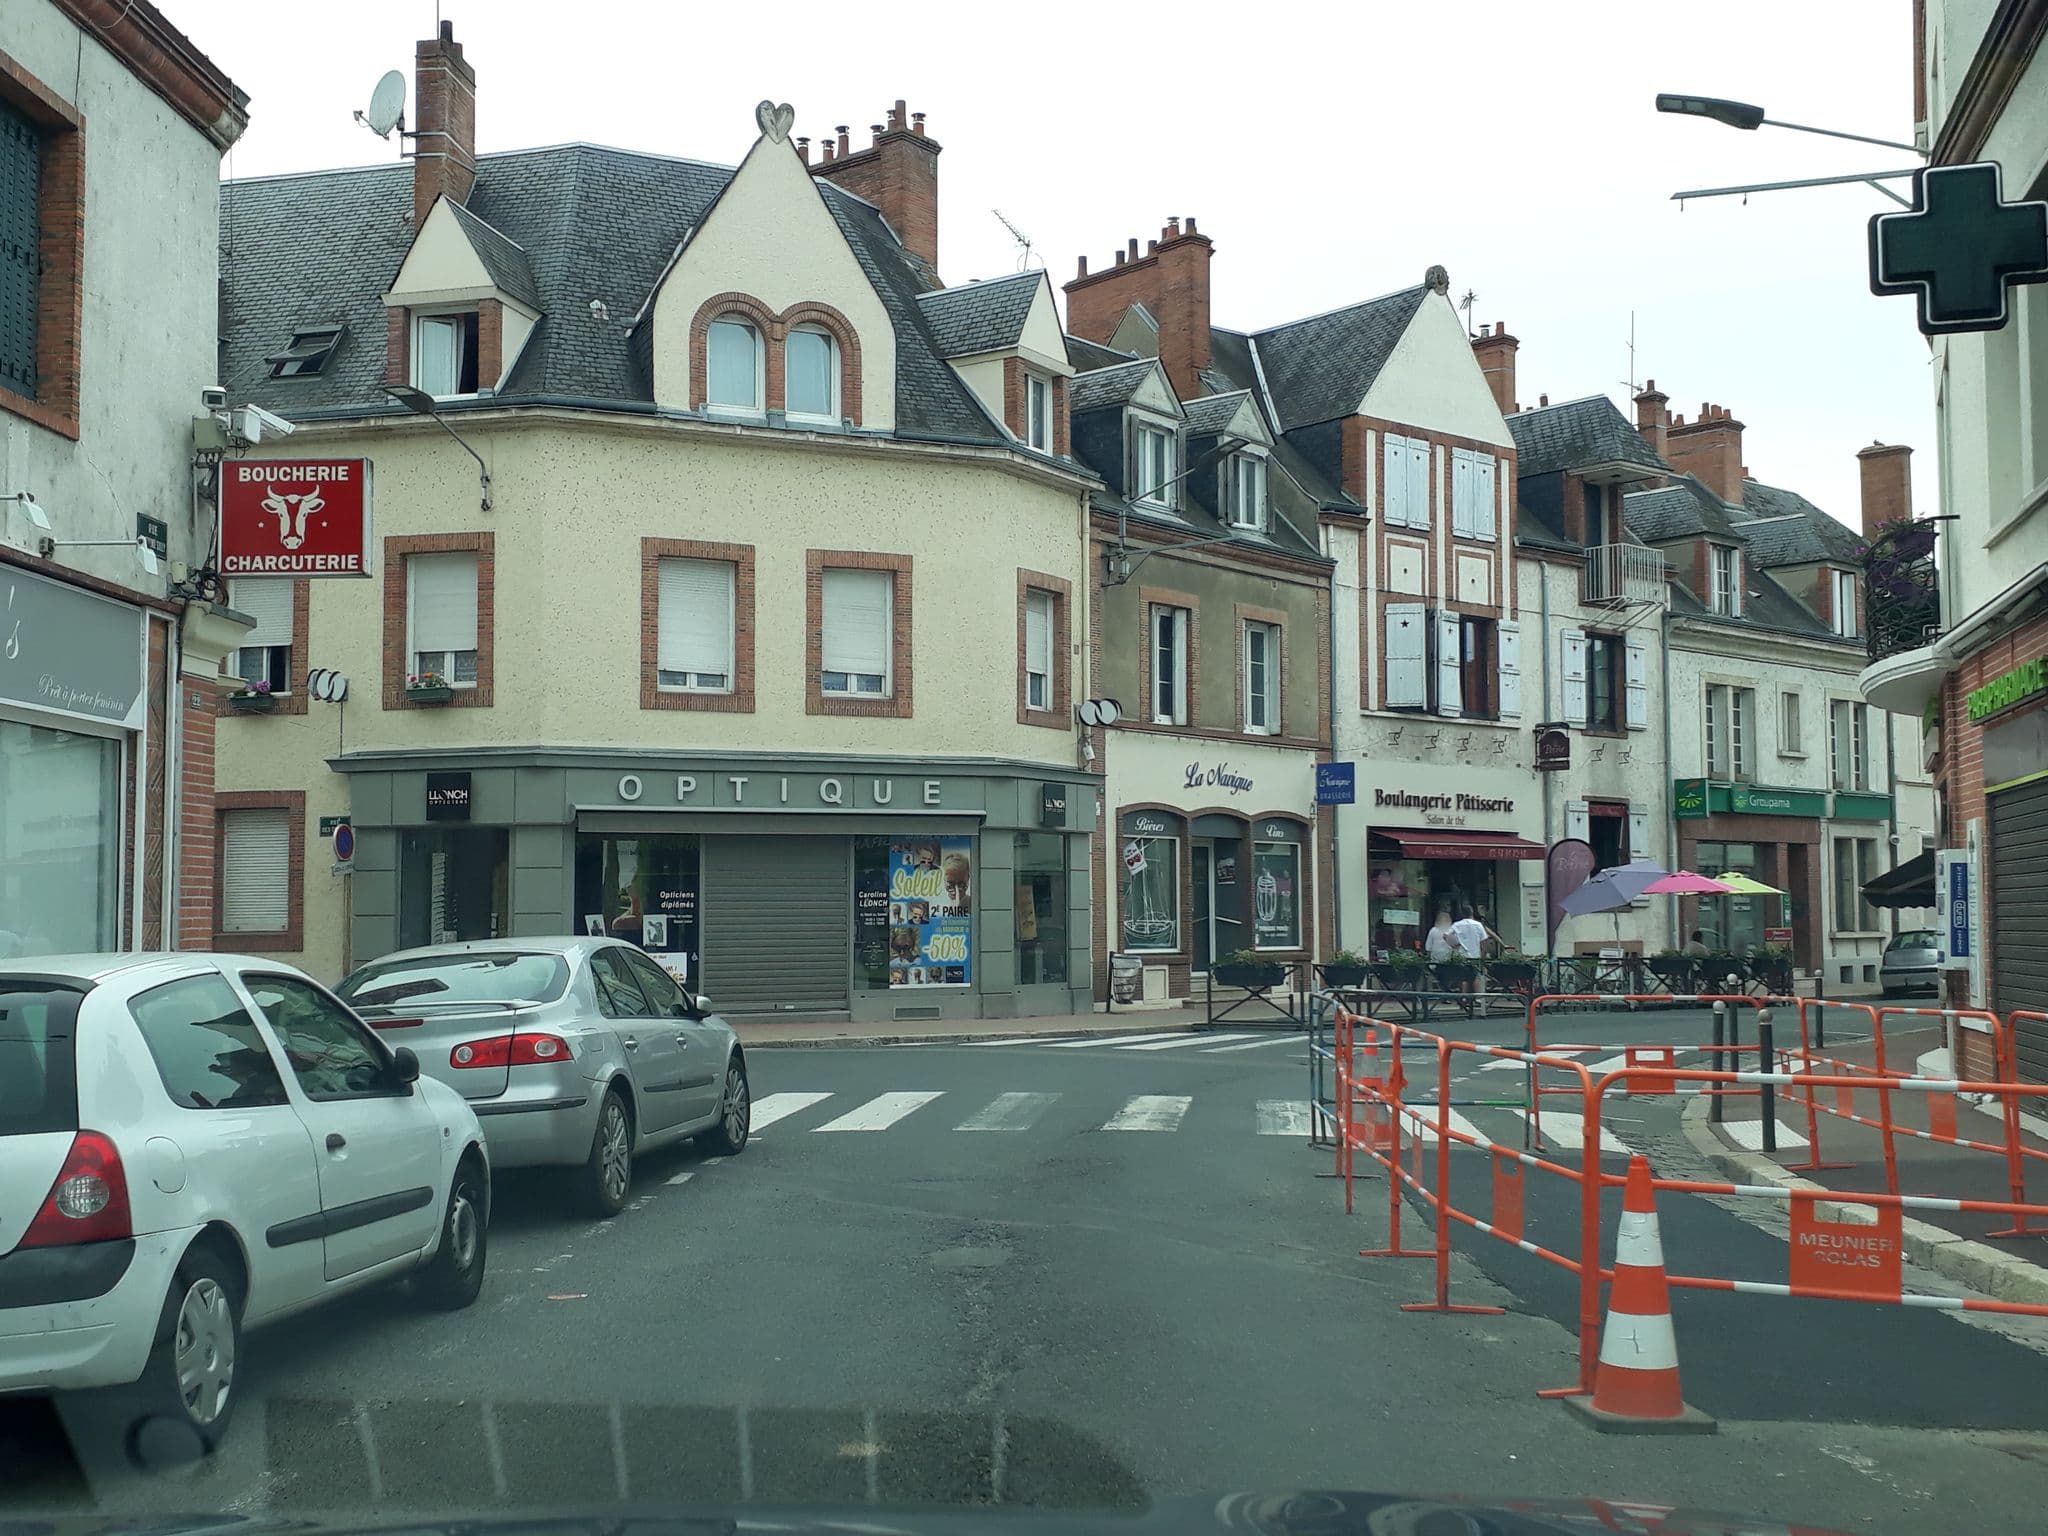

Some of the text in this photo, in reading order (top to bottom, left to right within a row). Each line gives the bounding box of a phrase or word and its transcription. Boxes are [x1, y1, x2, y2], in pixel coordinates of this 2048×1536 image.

[238, 465, 349, 482] BOUCHERIE
[224, 554, 359, 571] CHARCUTERIE
[1184, 761, 1253, 795] La Navigue
[619, 776, 941, 804] OPTIQUE
[1375, 789, 1514, 812] Boulangerie Pâtisserie
[1750, 795, 1791, 809] Groupama
[891, 868, 944, 898] Soleil
[660, 890, 695, 900] Opticiens
[661, 901, 694, 910] diplômés
[943, 906, 969, 917] PAIRE
[1956, 902, 1965, 926] durex
[922, 935, 967, 961] -50%
[1800, 1233, 1893, 1251] MEUNIER
